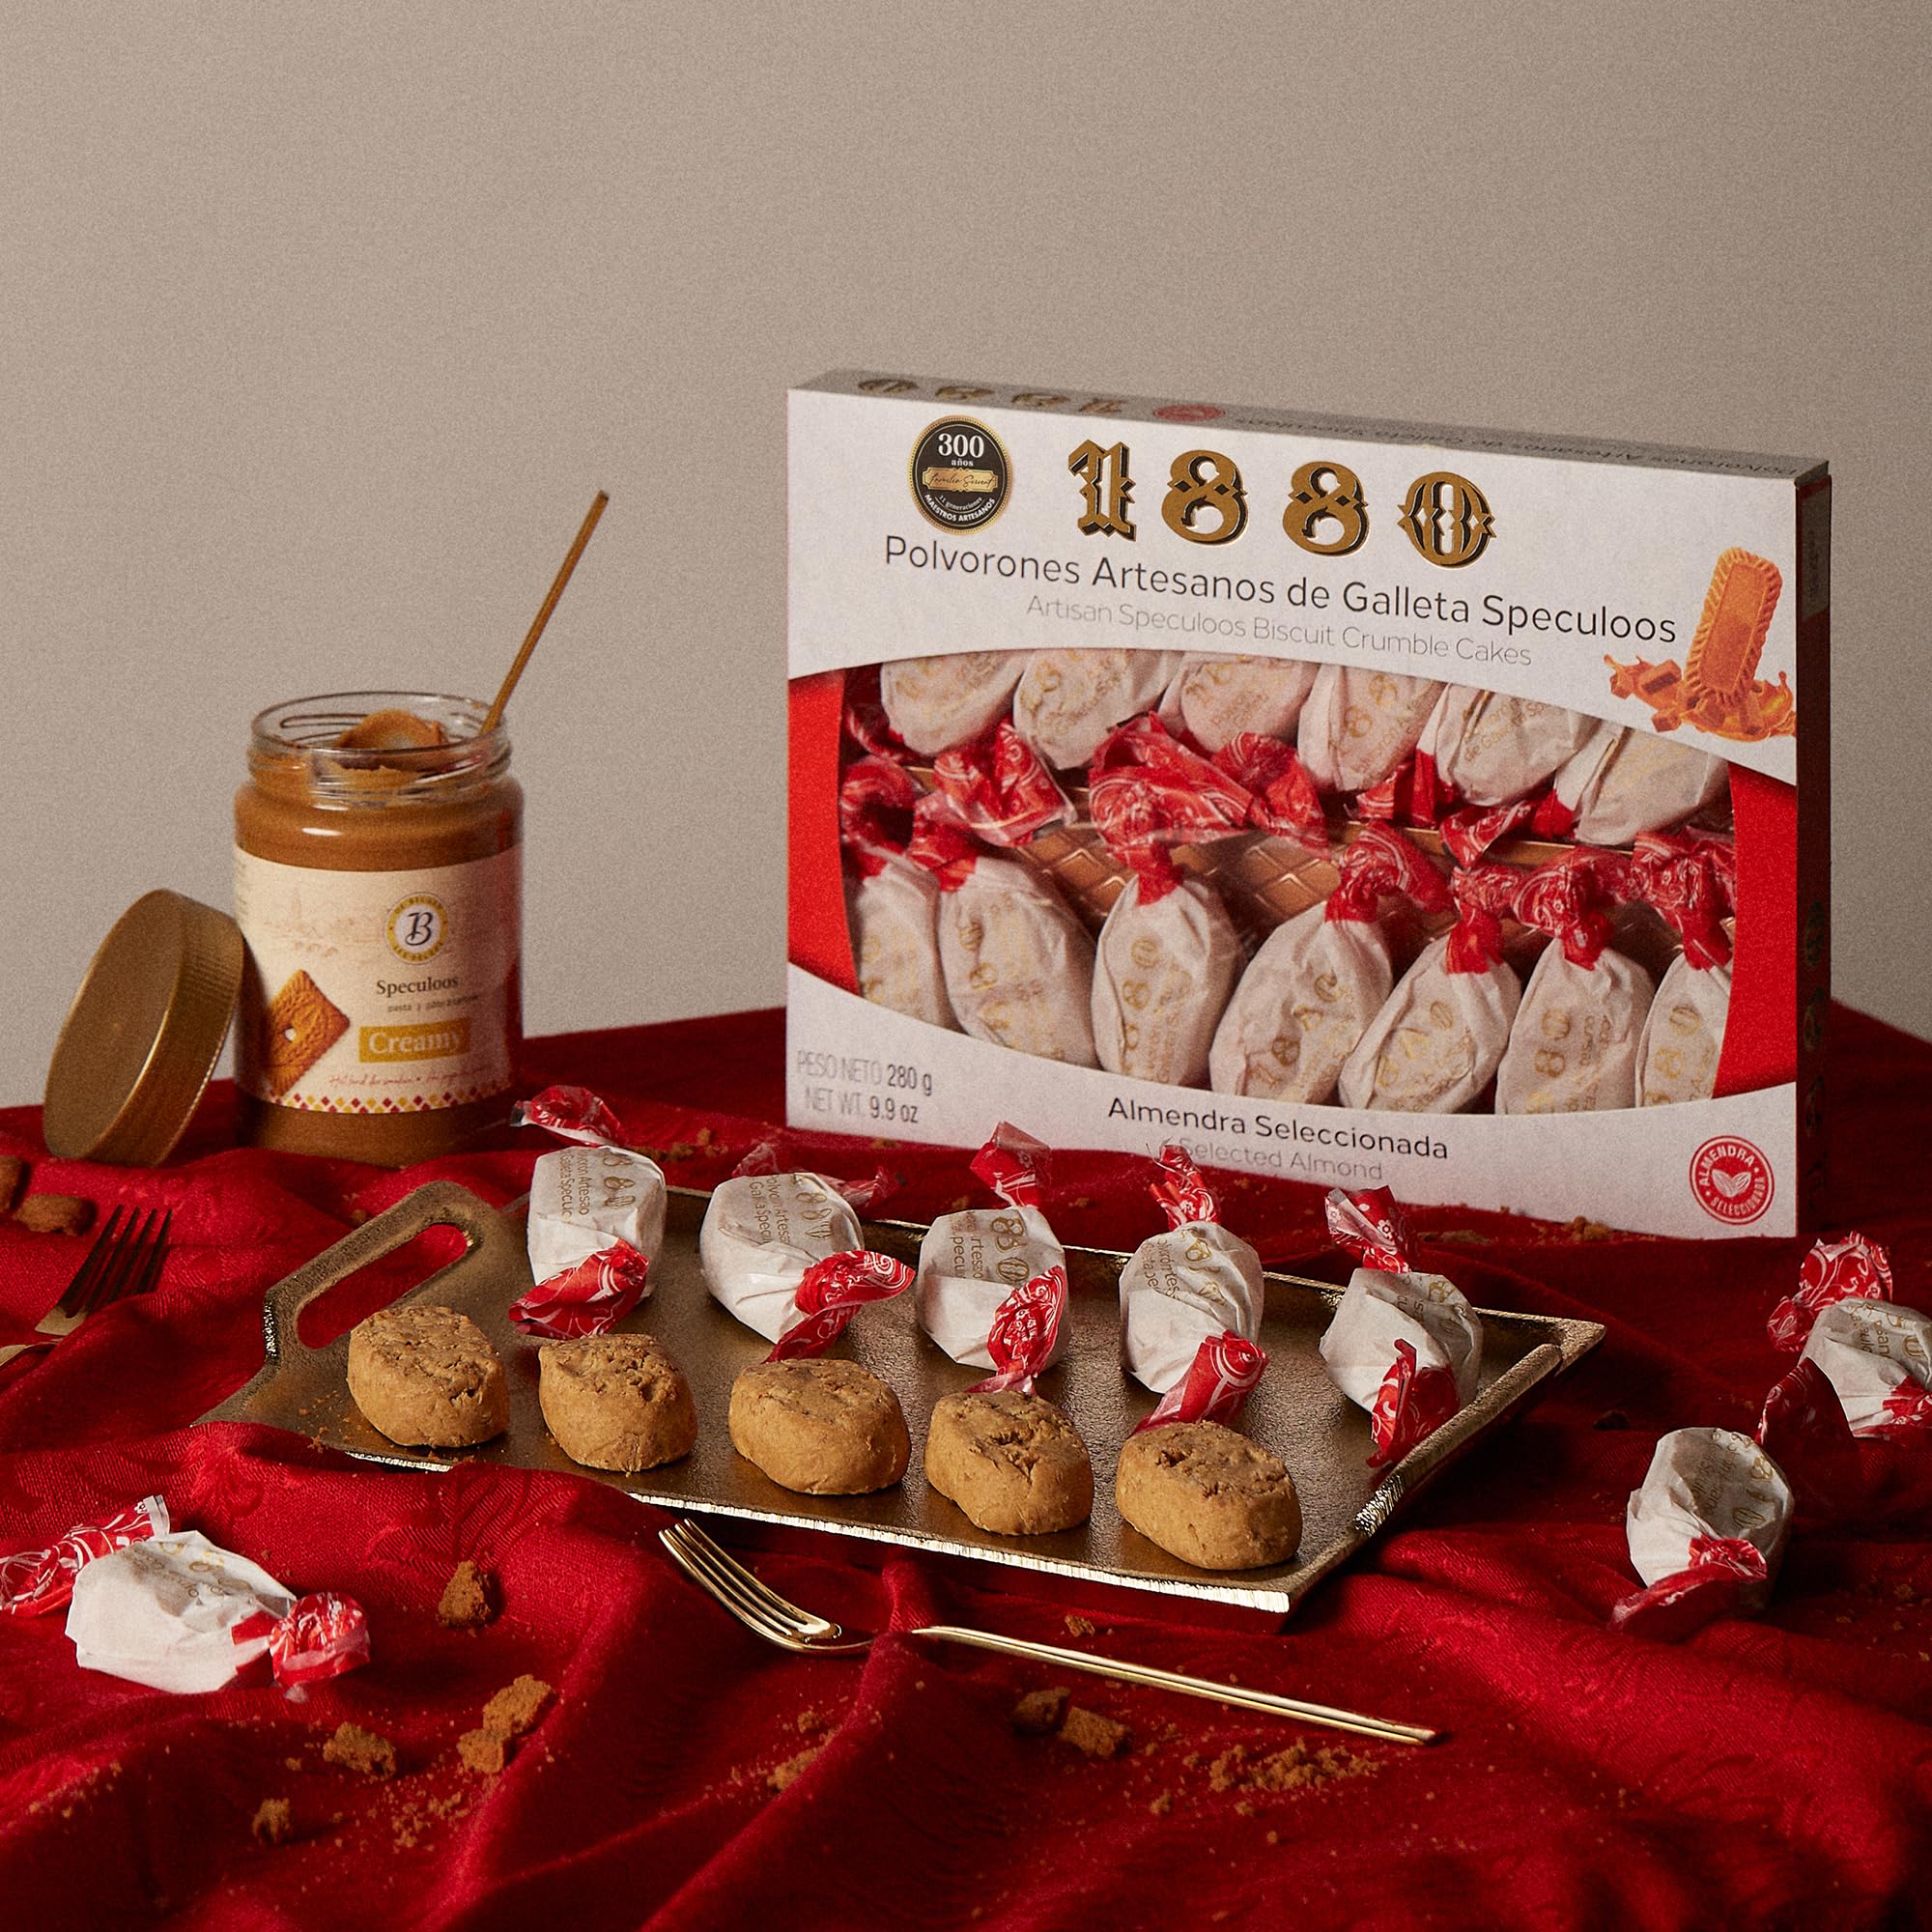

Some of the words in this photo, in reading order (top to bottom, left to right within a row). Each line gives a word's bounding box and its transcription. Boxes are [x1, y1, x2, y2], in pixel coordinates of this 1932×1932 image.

[938, 433, 984, 458] 300
[951, 458, 975, 467] años
[924, 494, 957, 522] MAESTROS
[958, 497, 996, 522] ARTESANOS
[1067, 439, 1497, 568] 1880
[886, 534, 1080, 585] Polvorones
[1092, 556, 1275, 604] Artesanos
[1287, 577, 1329, 609] de
[1343, 582, 1469, 623] Galleta
[1482, 594, 1676, 643] Speculoos
[1026, 595, 1111, 623] Artisan
[1119, 604, 1246, 638] Speculoos
[1255, 617, 1335, 646] Biscuit
[1342, 626, 1449, 657] Crumble
[1456, 637, 1532, 667] Cakes
[405, 911, 434, 946] B
[376, 976, 460, 998] Speculoos
[368, 1031, 462, 1054] Creamy
[798, 1050, 838, 1080] PESO
[841, 1056, 883, 1086] NETO
[887, 1064, 918, 1090] 280
[922, 1073, 933, 1096] g
[804, 1085, 834, 1112] NET
[869, 1095, 895, 1121] 9.9
[899, 1104, 919, 1123] oz
[1108, 1097, 1246, 1134] Almendra
[1255, 1115, 1449, 1159] Seleccionada
[1179, 1137, 1282, 1168] Selected
[1290, 1151, 1383, 1180] Almond
[1699, 1145, 1755, 1187] ALMENDRA
